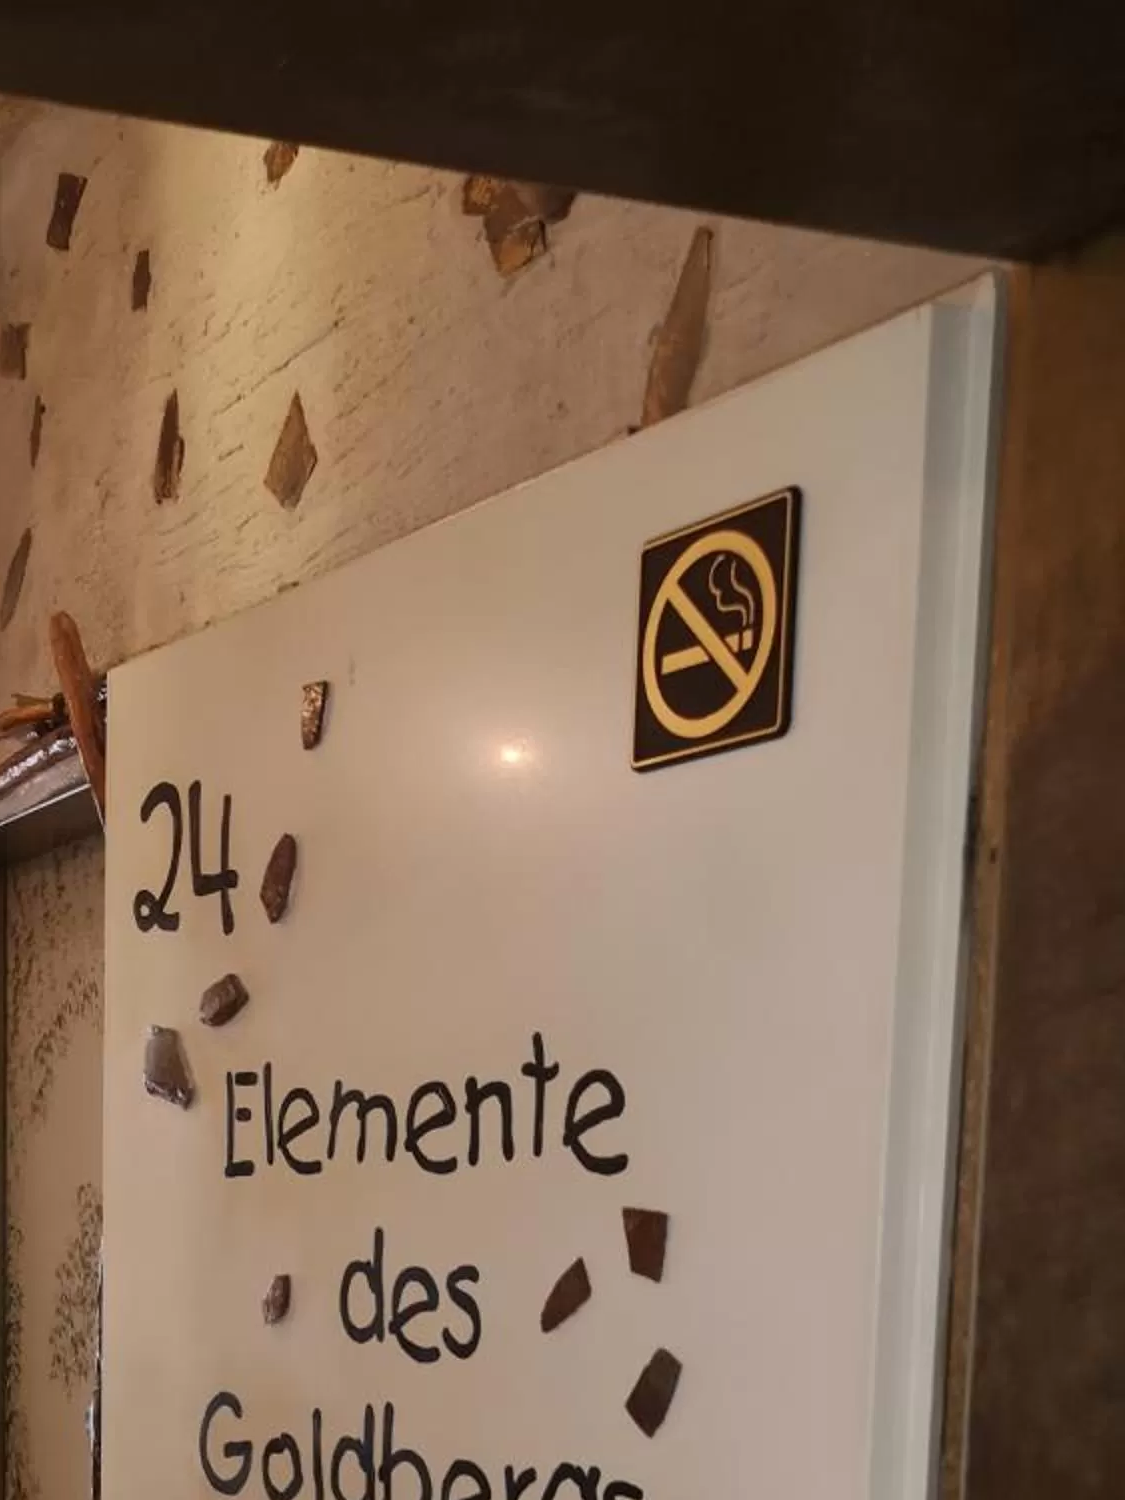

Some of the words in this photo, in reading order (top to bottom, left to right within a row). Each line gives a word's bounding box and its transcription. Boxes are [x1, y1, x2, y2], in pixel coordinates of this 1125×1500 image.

[134, 780, 239, 935] 24
[224, 1032, 630, 1178] Elemente
[339, 1227, 482, 1363] des
